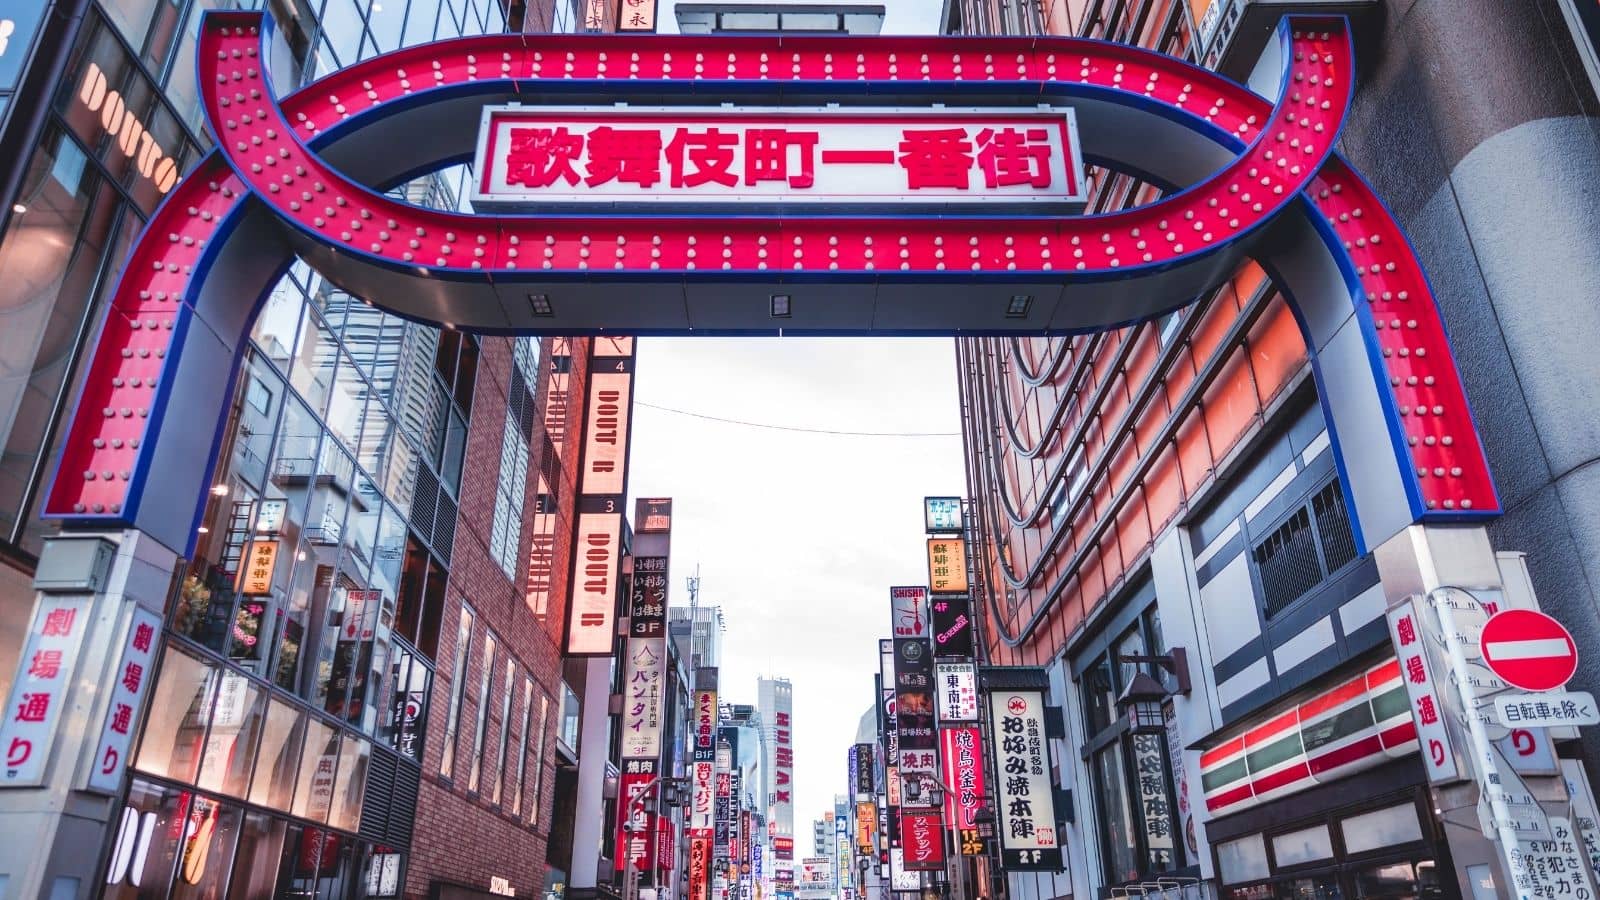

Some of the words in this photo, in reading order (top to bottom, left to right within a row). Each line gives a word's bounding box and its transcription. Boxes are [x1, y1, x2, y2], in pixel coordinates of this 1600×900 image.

[80, 62, 182, 194] DOUTO
[505, 126, 1052, 190] 歌舞伎町一番街
[615, 361, 624, 372] 4
[592, 390, 620, 473] DOUTR
[605, 500, 614, 512] 3
[580, 533, 611, 627] DOUTR
[632, 577, 644, 617] いろは
[893, 589, 925, 598] SHISHA
[636, 622, 660, 633] 3F
[935, 603, 948, 613] 4F
[8, 608, 77, 767] 劇場通り
[102, 621, 155, 775] 劇場通り
[947, 673, 962, 719] 東南荘
[1397, 614, 1445, 767] 劇場通り
[1504, 700, 1592, 721] 自転車を除く
[627, 761, 653, 773] 焼肉
[695, 750, 714, 759] B1F
[775, 711, 793, 804] HUMAX
[955, 729, 977, 827] 焼鳥釜めし
[1002, 716, 1035, 839] お好み焼本陣
[913, 817, 932, 861] ステップ
[962, 844, 983, 855] 2F
[1019, 850, 1042, 865] 2F
[1524, 855, 1544, 898] Security
[1535, 856, 1550, 881] Your
[1555, 826, 1590, 900] みなさまの
